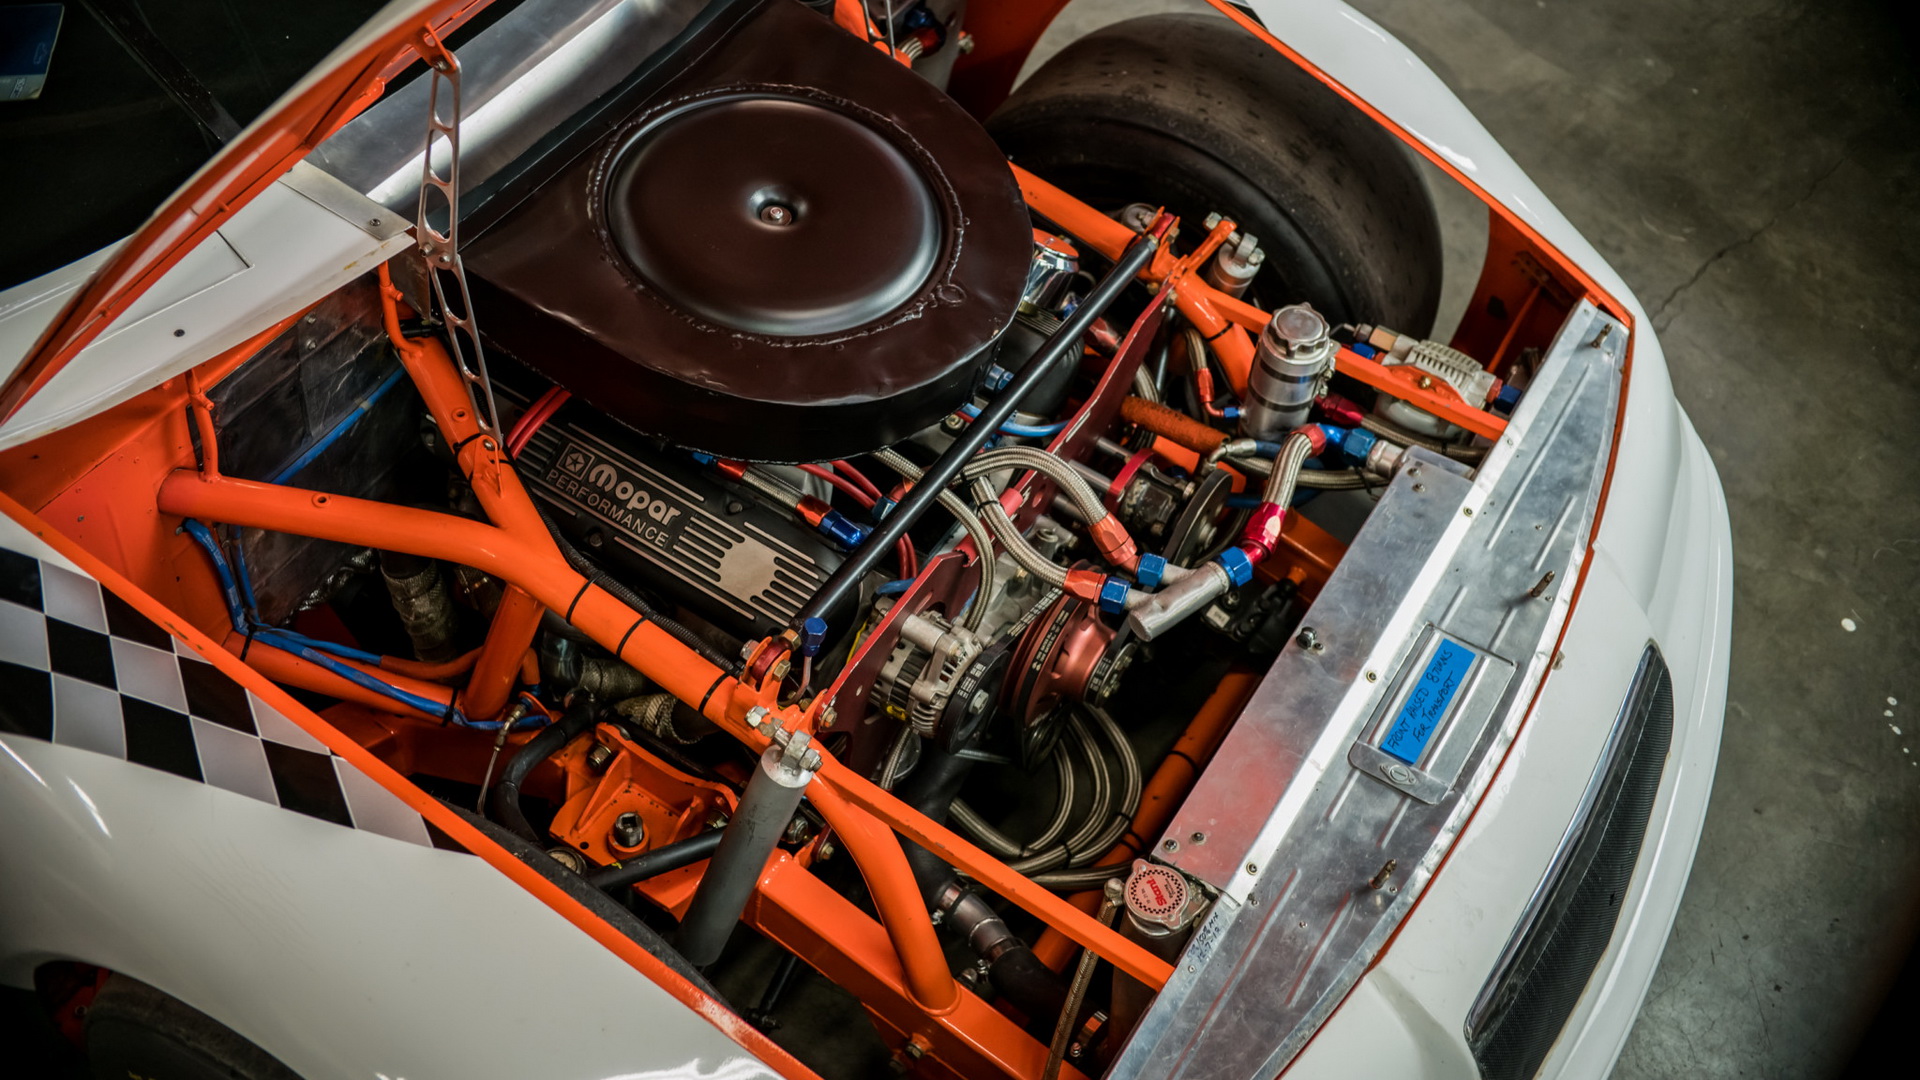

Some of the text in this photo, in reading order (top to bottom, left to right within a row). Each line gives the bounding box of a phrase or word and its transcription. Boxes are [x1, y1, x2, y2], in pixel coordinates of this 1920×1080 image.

[546, 469, 669, 547] PERFORMANCE
[1387, 649, 1453, 751] FRONT RAISED 8 TURNS
[1146, 879, 1167, 906] Stant
